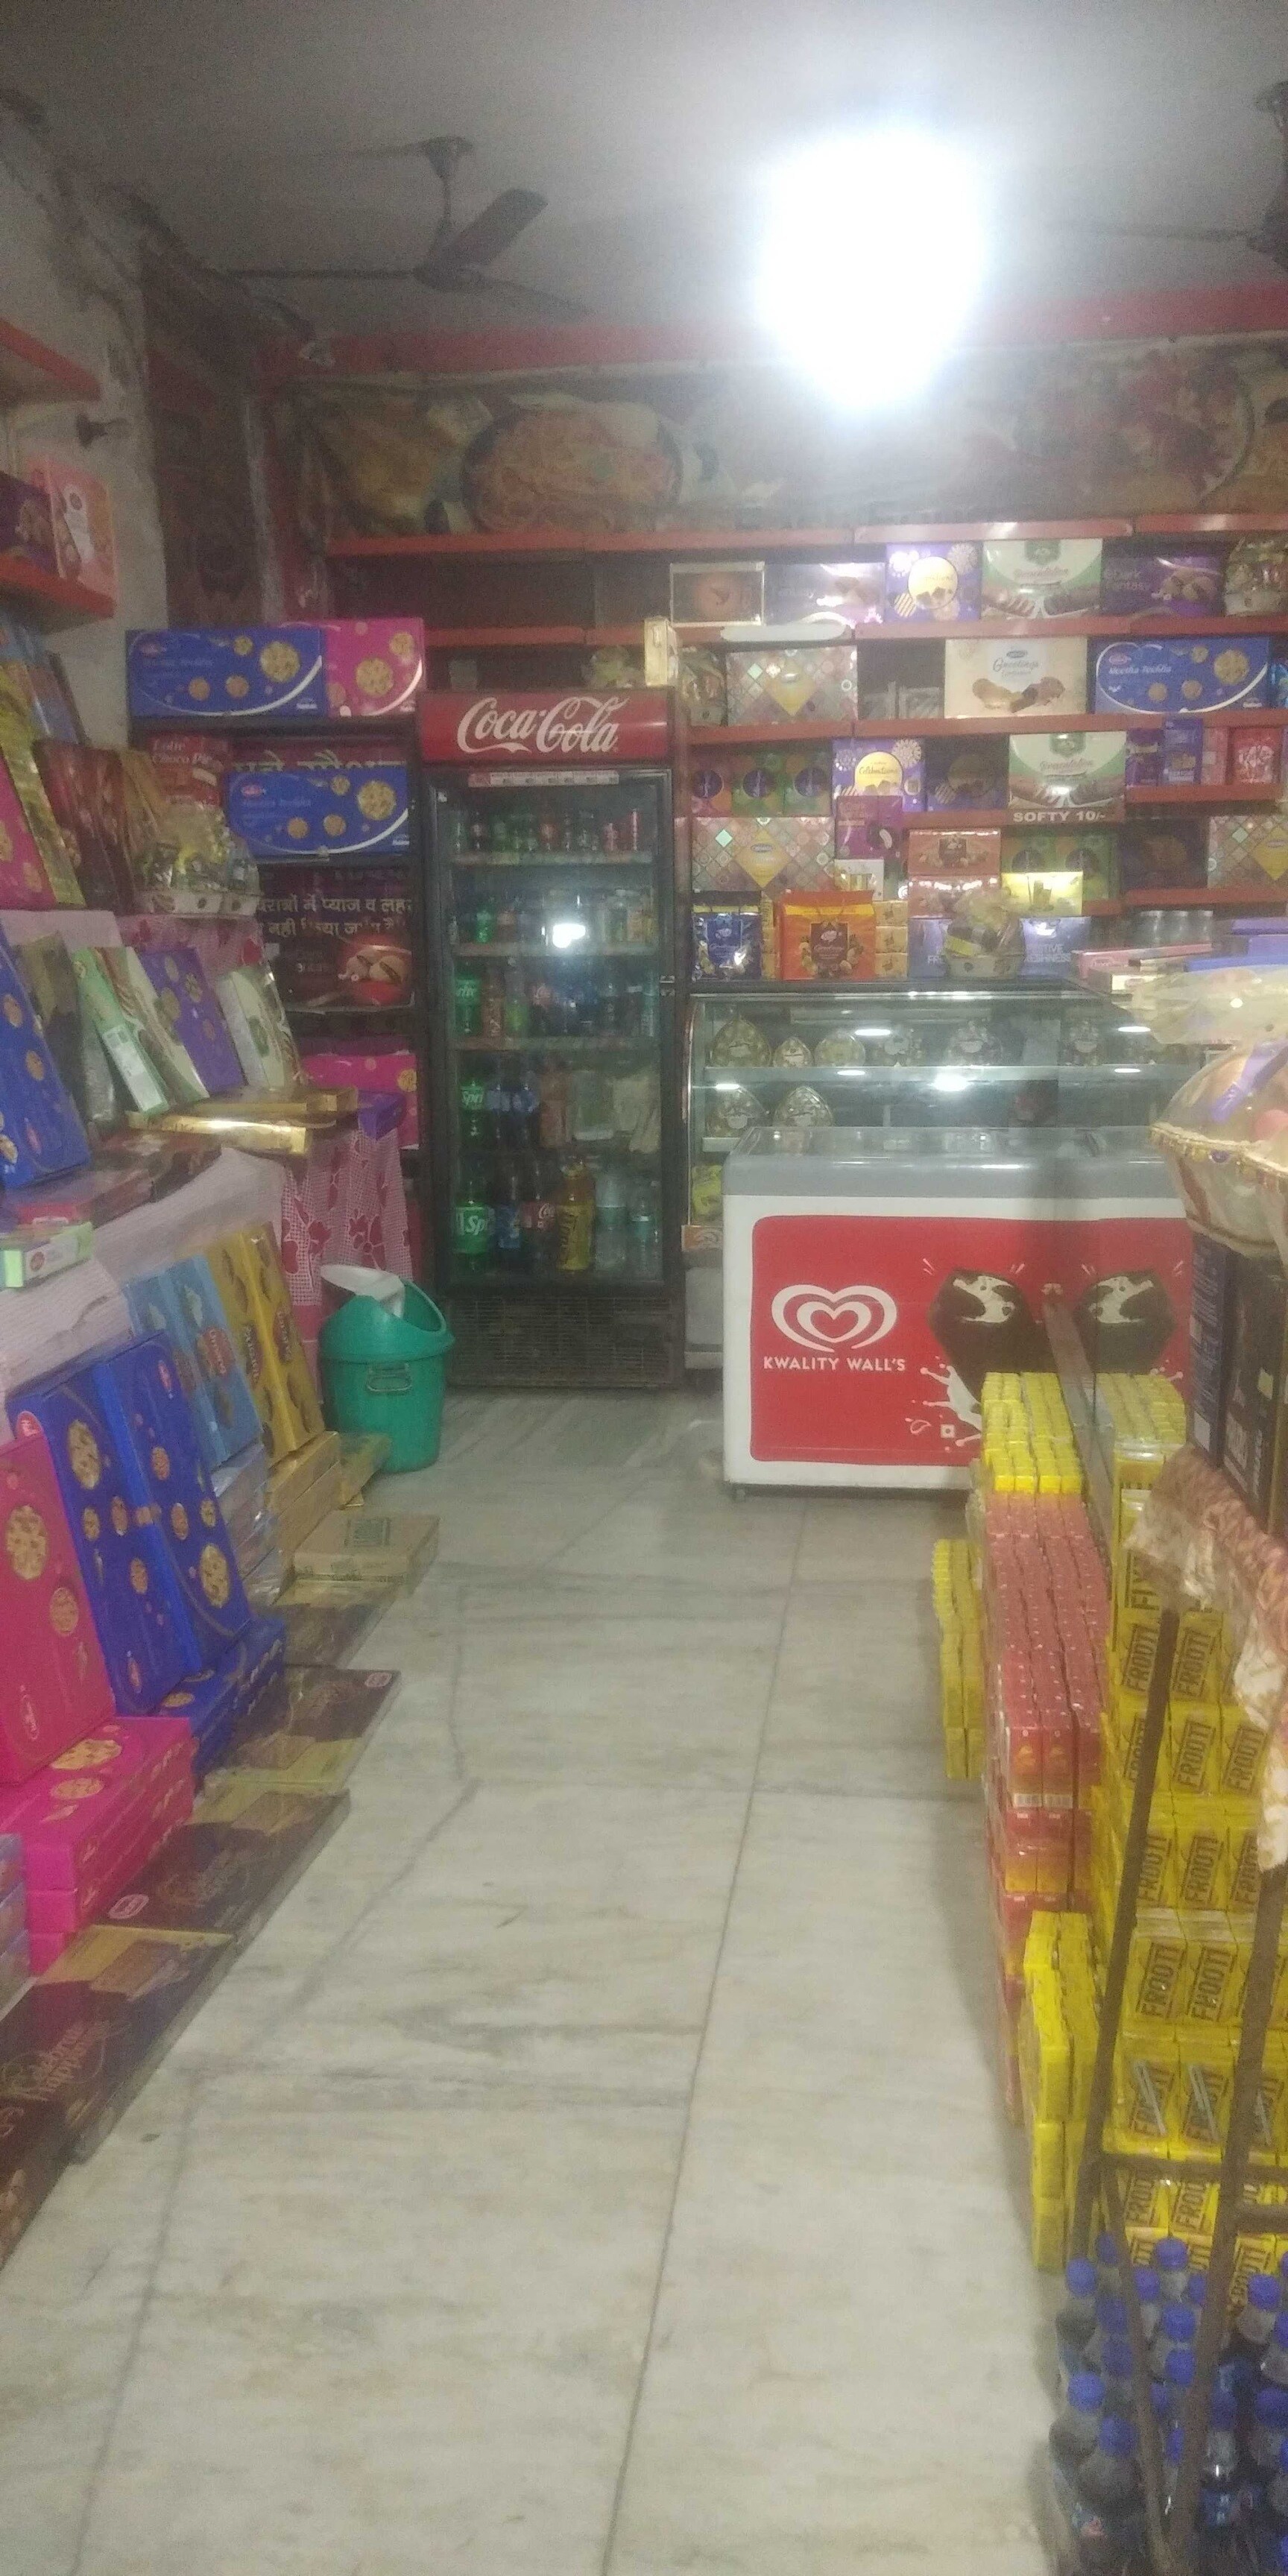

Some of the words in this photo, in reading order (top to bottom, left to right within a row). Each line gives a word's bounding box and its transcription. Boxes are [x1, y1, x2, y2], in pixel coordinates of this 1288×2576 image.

[456, 696, 631, 754] Coca-Cola
[1013, 810, 1070, 822] SOFTY
[1076, 809, 1105, 821] 10/-
[763, 1356, 839, 1371] KWALITY
[847, 1357, 906, 1372] WALL'S
